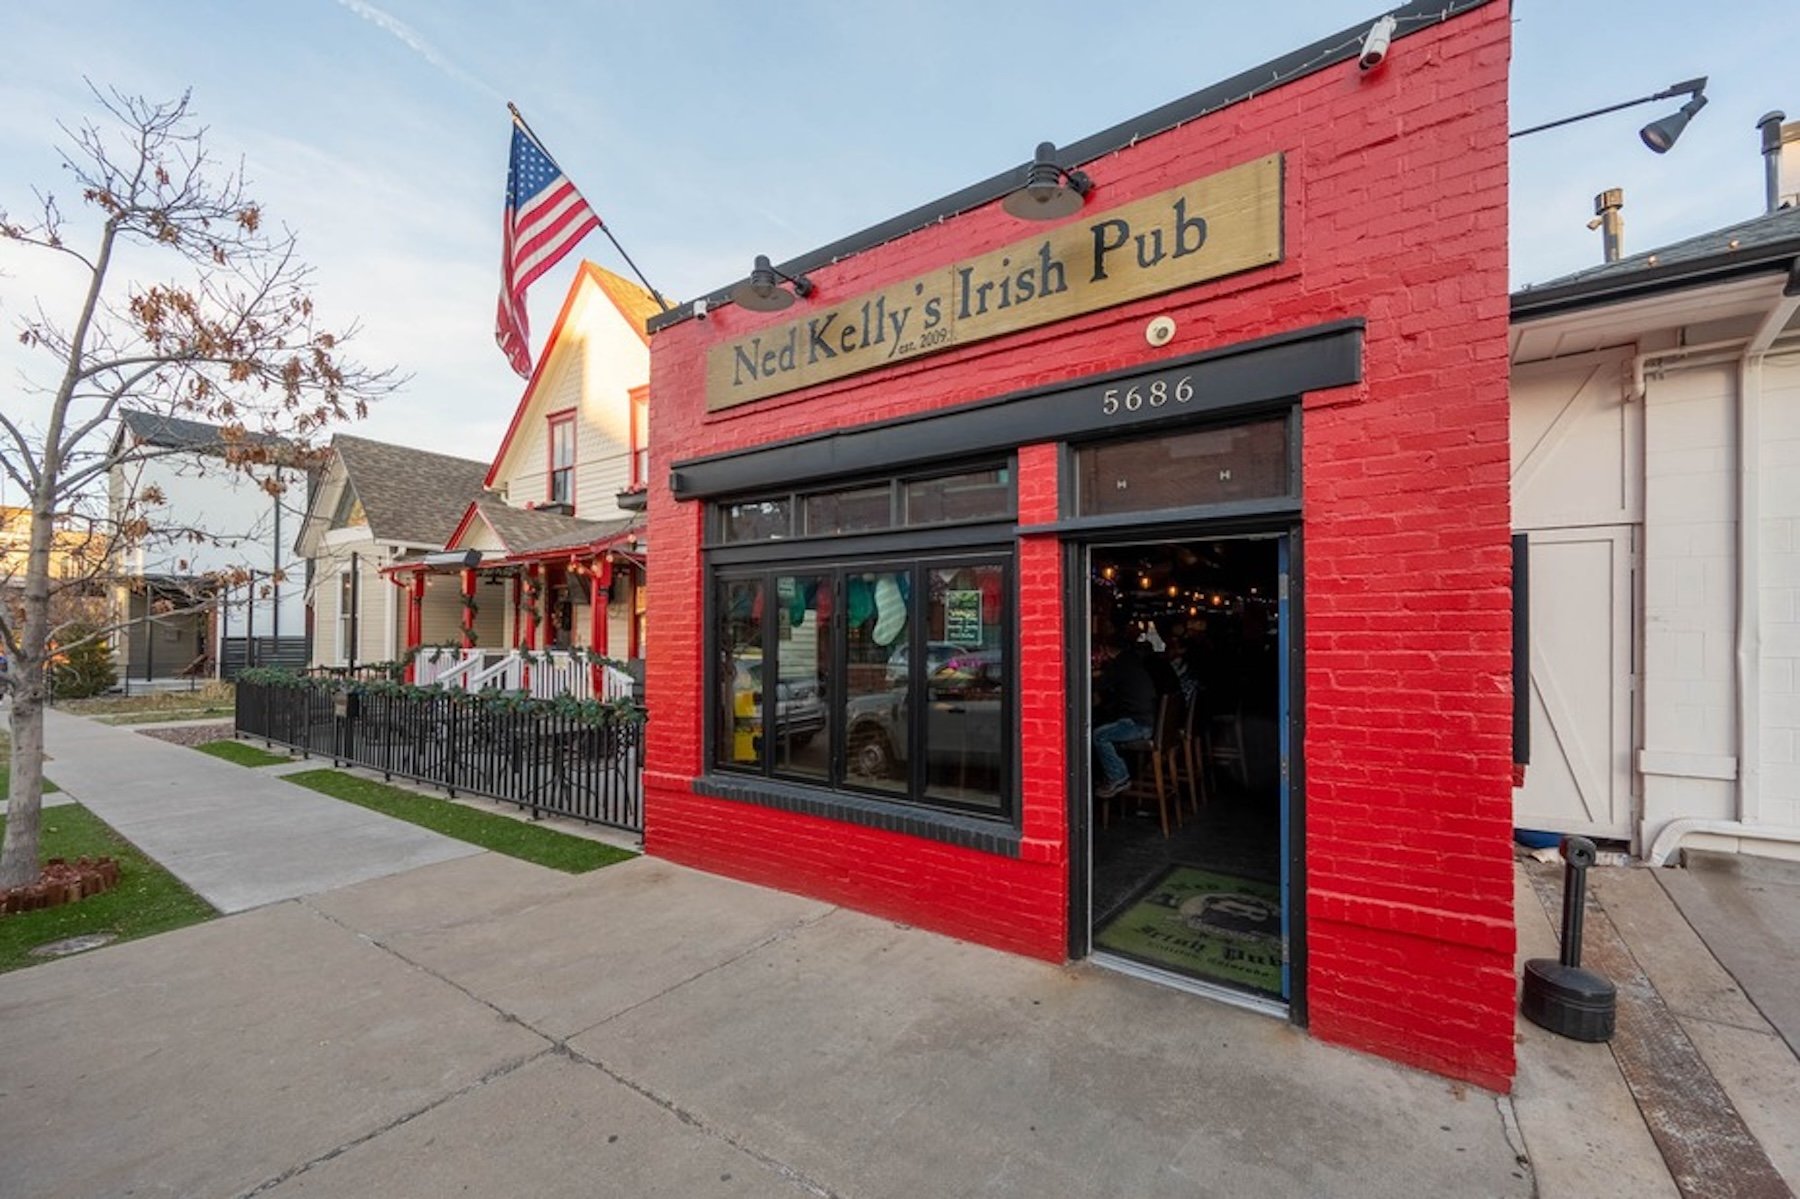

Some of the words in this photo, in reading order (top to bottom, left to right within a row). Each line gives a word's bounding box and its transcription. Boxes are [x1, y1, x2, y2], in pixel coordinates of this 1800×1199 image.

[733, 326, 797, 386] Ned
[807, 282, 941, 365] Kelly's
[958, 240, 1068, 320] Irish
[1089, 196, 1208, 284] Pub
[1103, 375, 1194, 415] 5686
